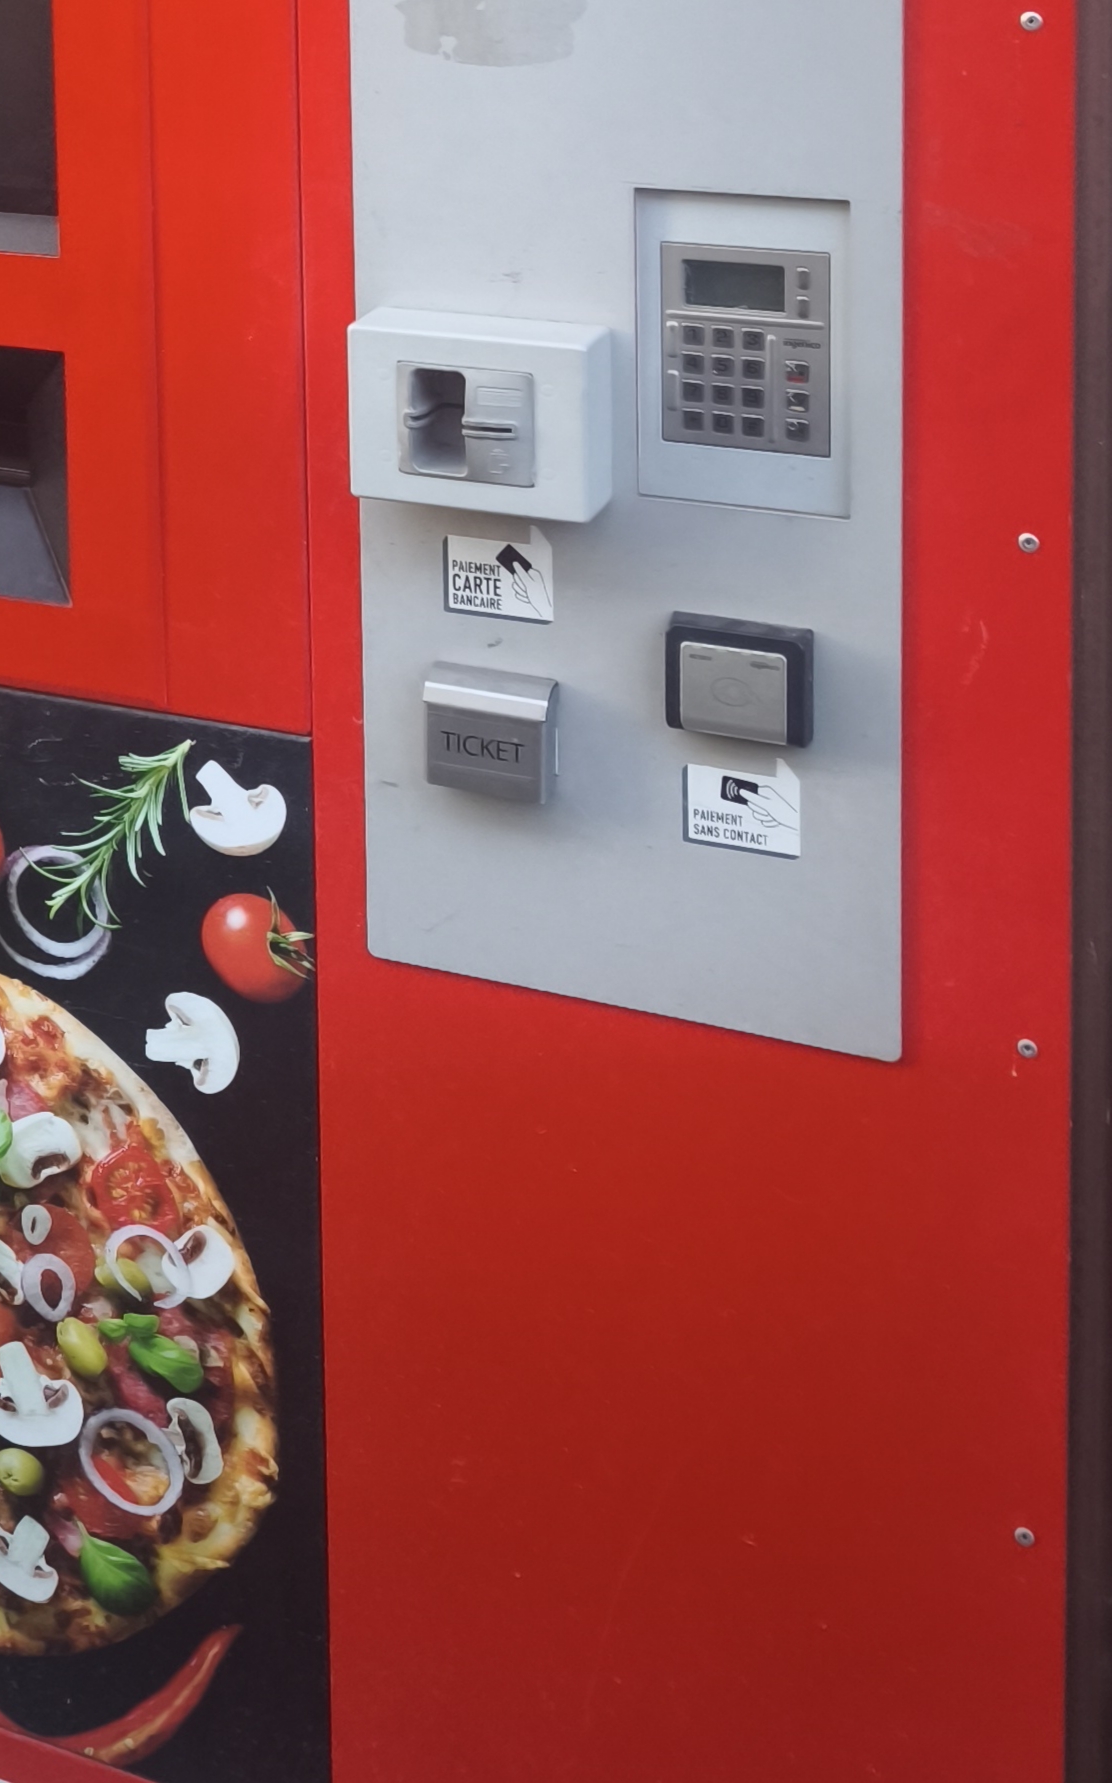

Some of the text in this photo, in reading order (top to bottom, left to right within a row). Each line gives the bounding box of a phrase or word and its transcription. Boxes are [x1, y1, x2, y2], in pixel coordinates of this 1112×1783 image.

[452, 559, 501, 577] PAIEMENT
[452, 573, 502, 597] CARTE
[453, 593, 502, 611] BANCAIRE
[440, 730, 525, 763] TICKET
[693, 808, 743, 827] PAIEMENT
[693, 823, 768, 846] SANS CONTACT
